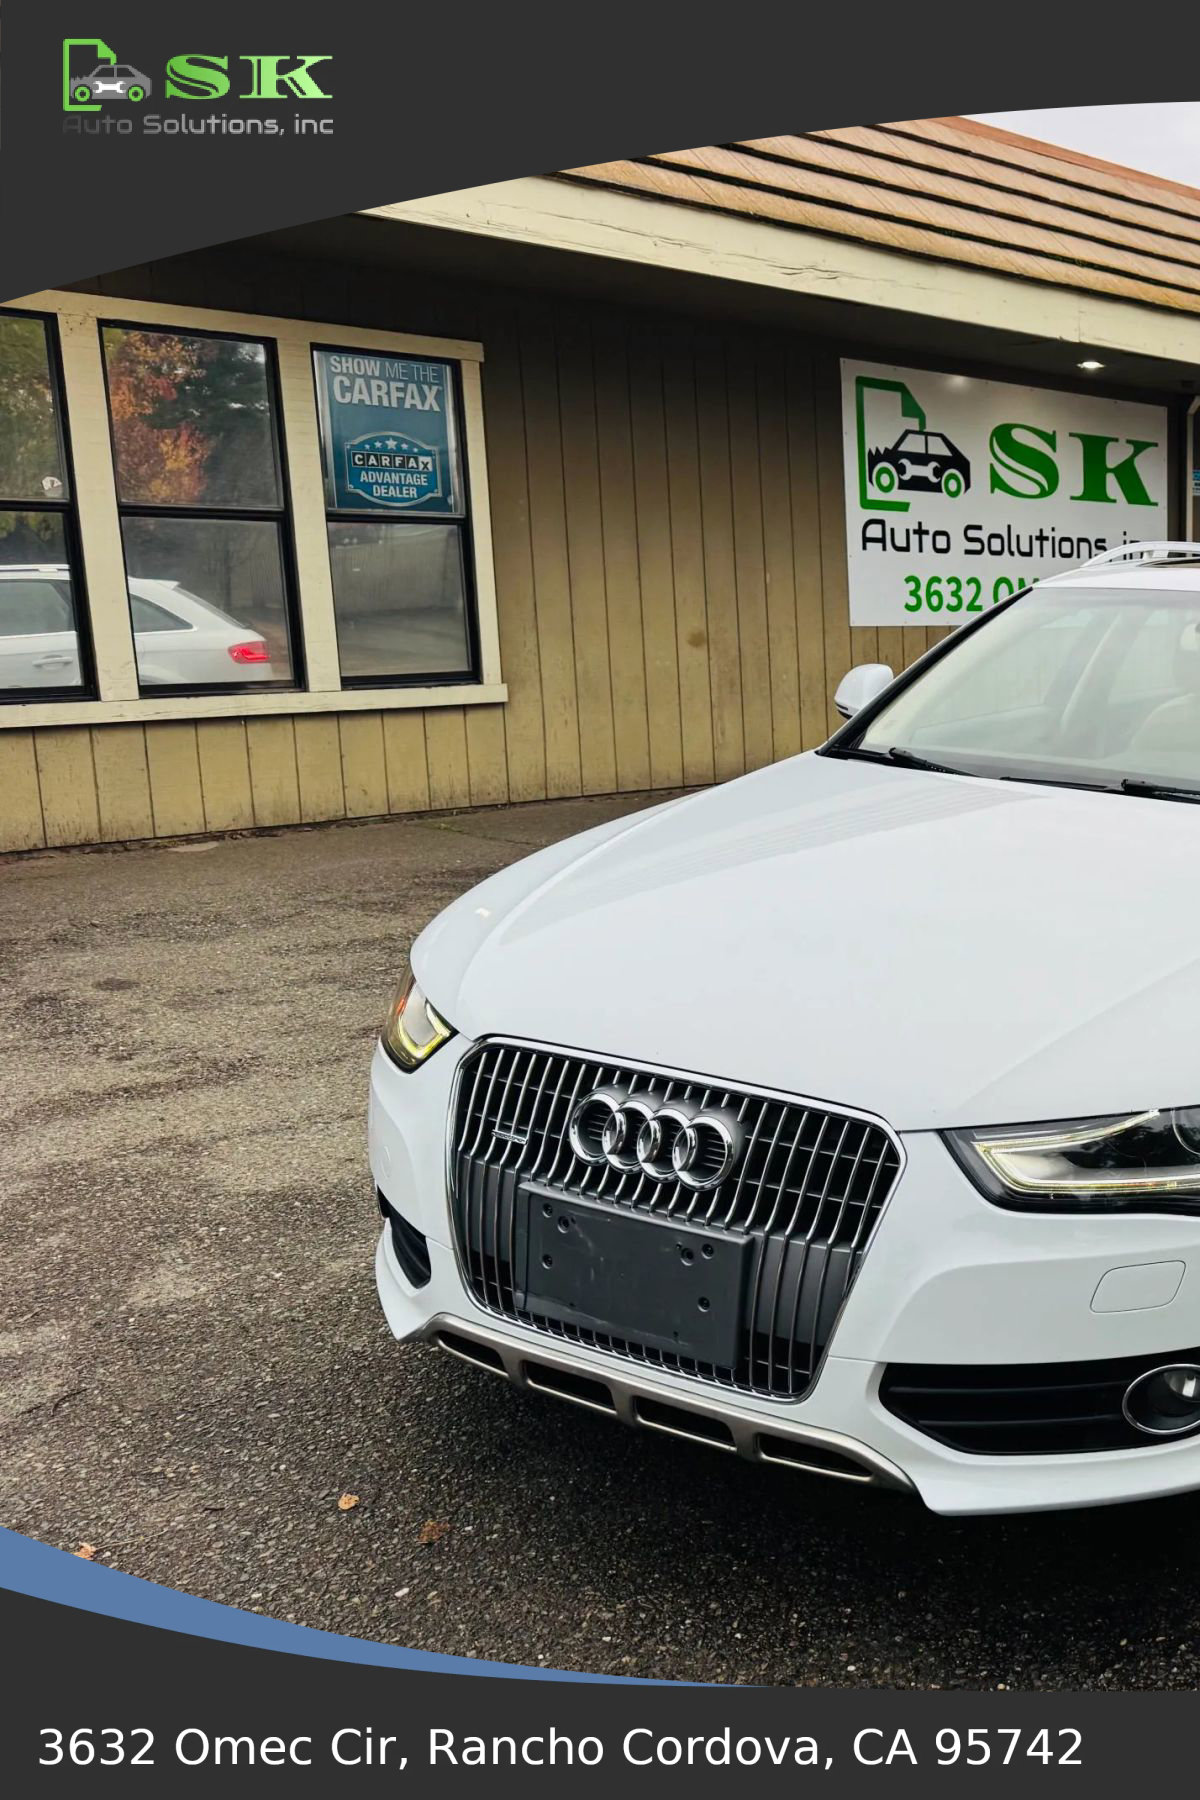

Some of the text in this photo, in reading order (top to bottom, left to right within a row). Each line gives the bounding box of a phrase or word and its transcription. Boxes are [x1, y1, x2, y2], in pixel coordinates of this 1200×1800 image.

[330, 355, 440, 383] SHOW ME THE
[333, 375, 441, 412] CARFAX
[353, 453, 431, 471] CARFAX
[360, 470, 428, 486] ADVANTAGE
[989, 423, 1159, 506] SK
[373, 484, 418, 498] DEALER
[861, 518, 951, 554] Auto
[903, 575, 984, 613] 3632
